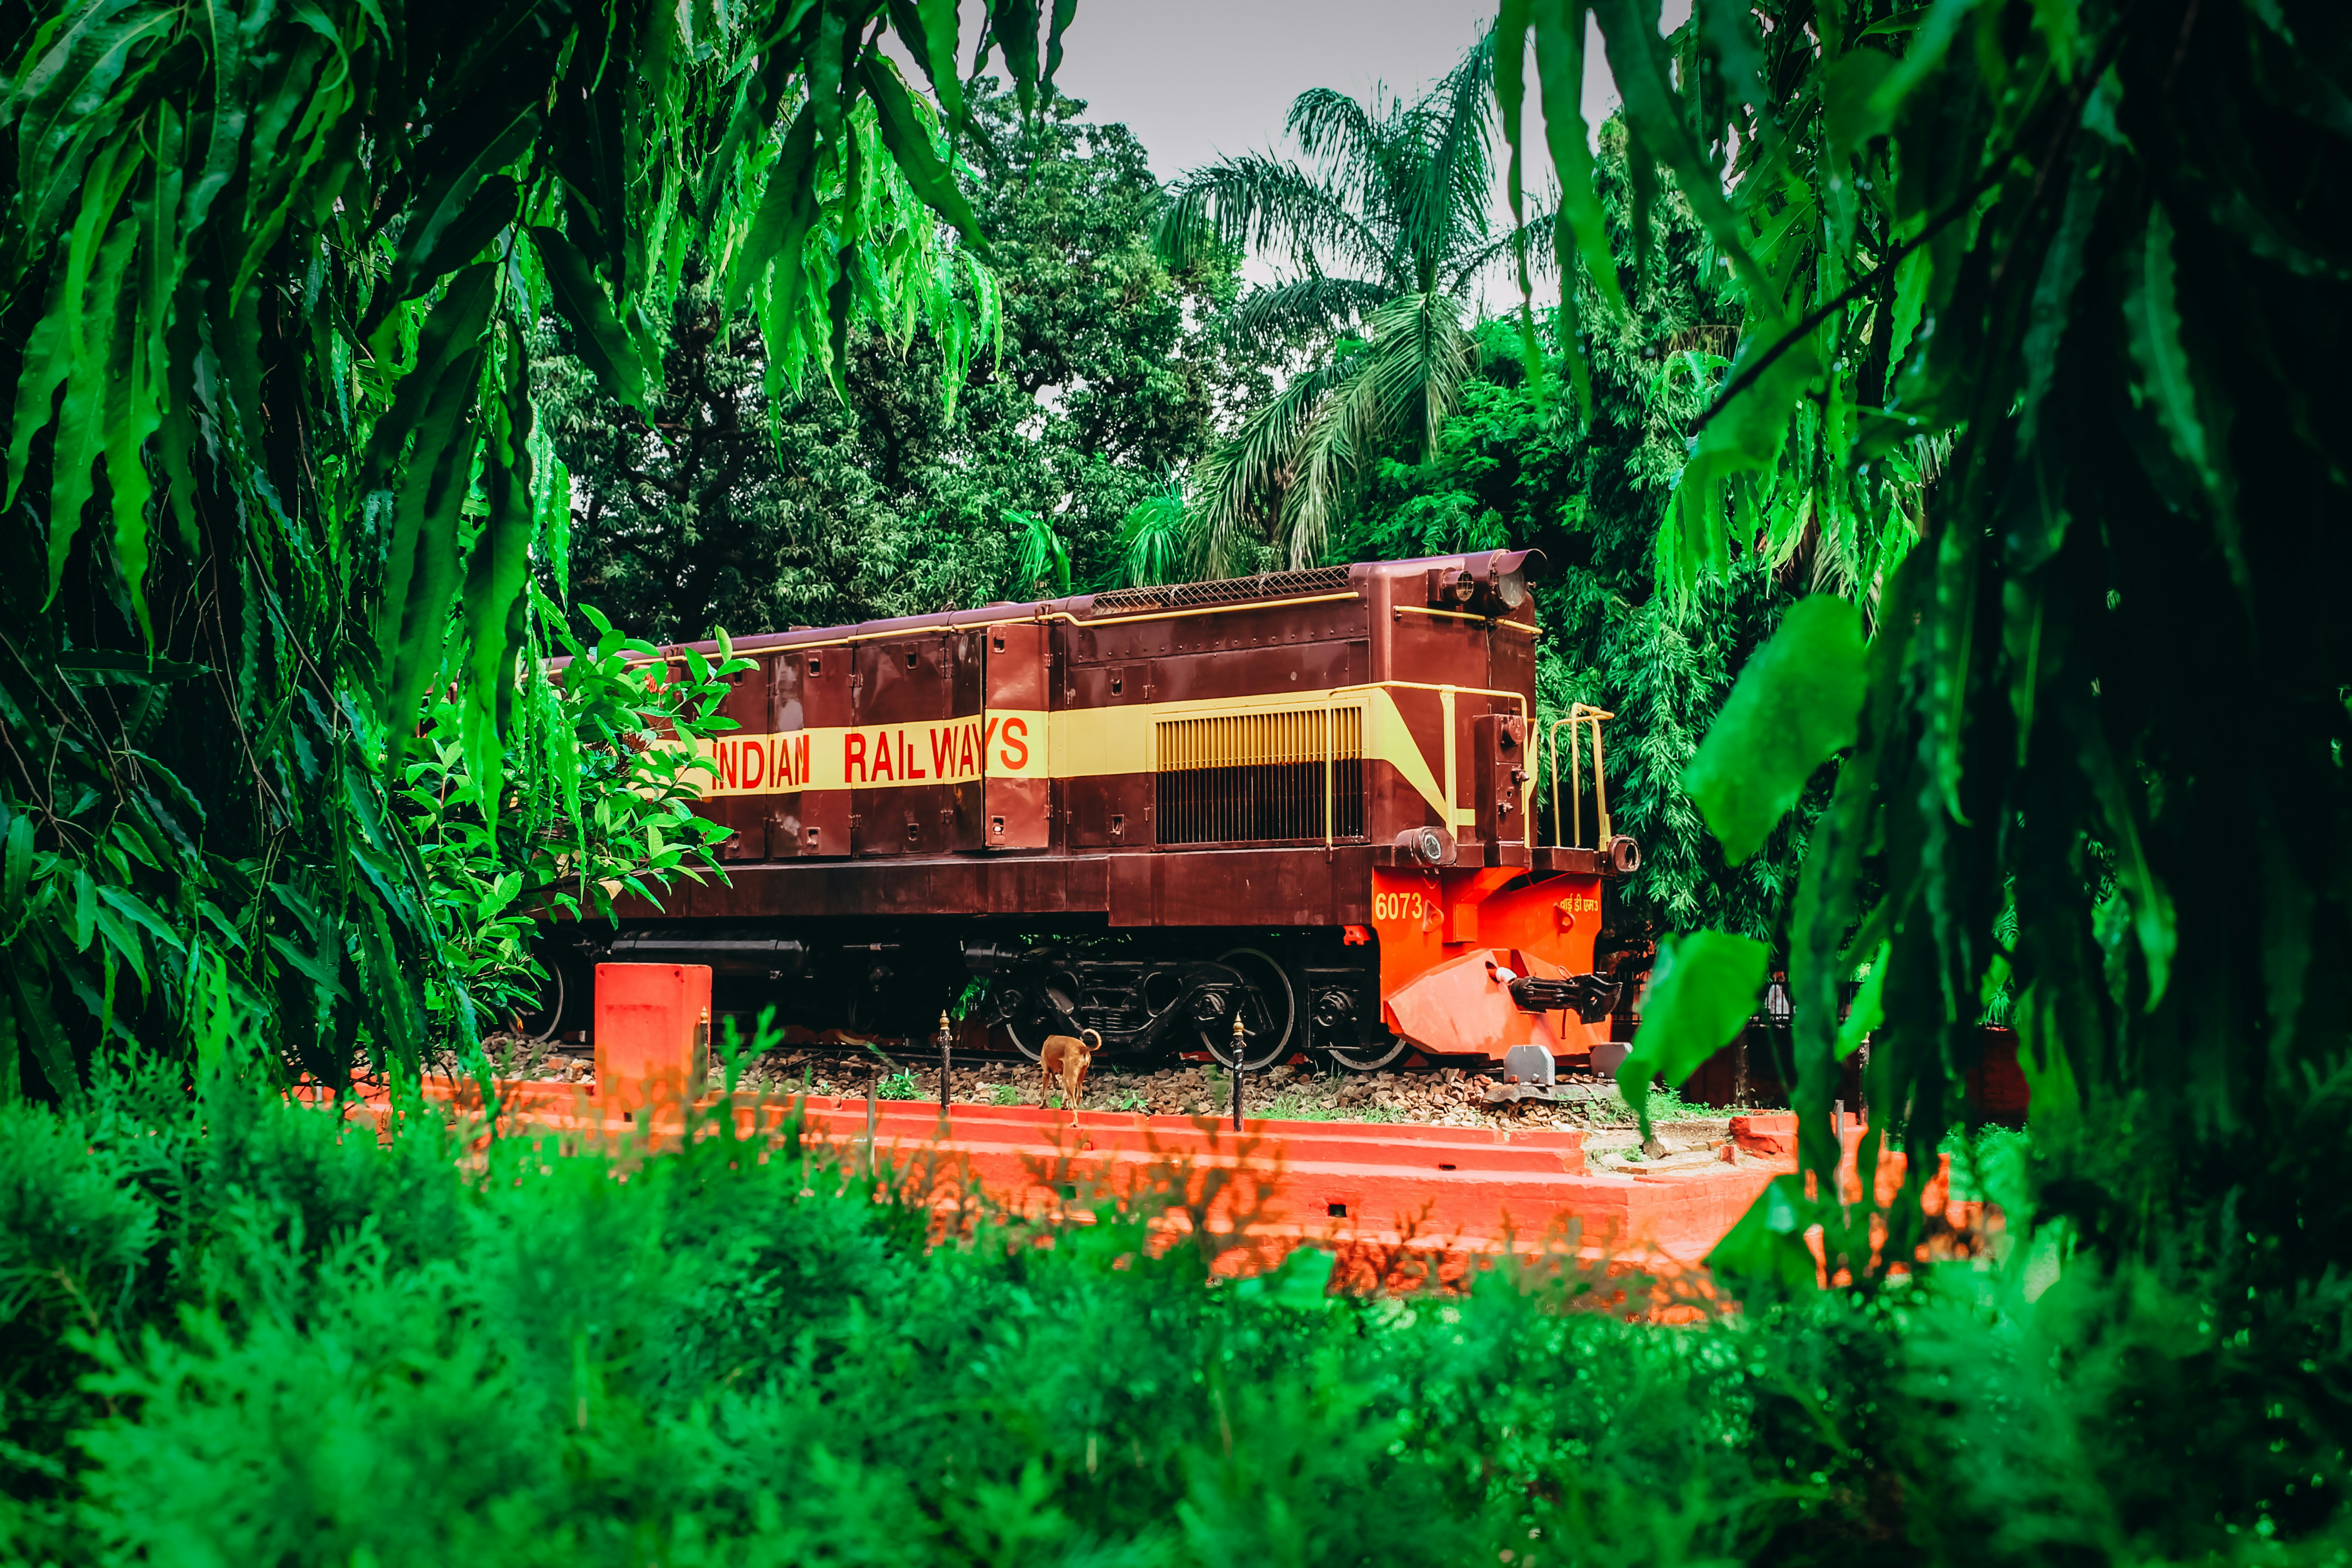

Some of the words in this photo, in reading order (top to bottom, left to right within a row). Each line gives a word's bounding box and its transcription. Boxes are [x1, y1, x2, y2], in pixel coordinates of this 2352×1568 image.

[712, 735, 809, 790] INDIAN
[845, 717, 1029, 783] RAILWAYS
[1375, 892, 1422, 920] 6073
